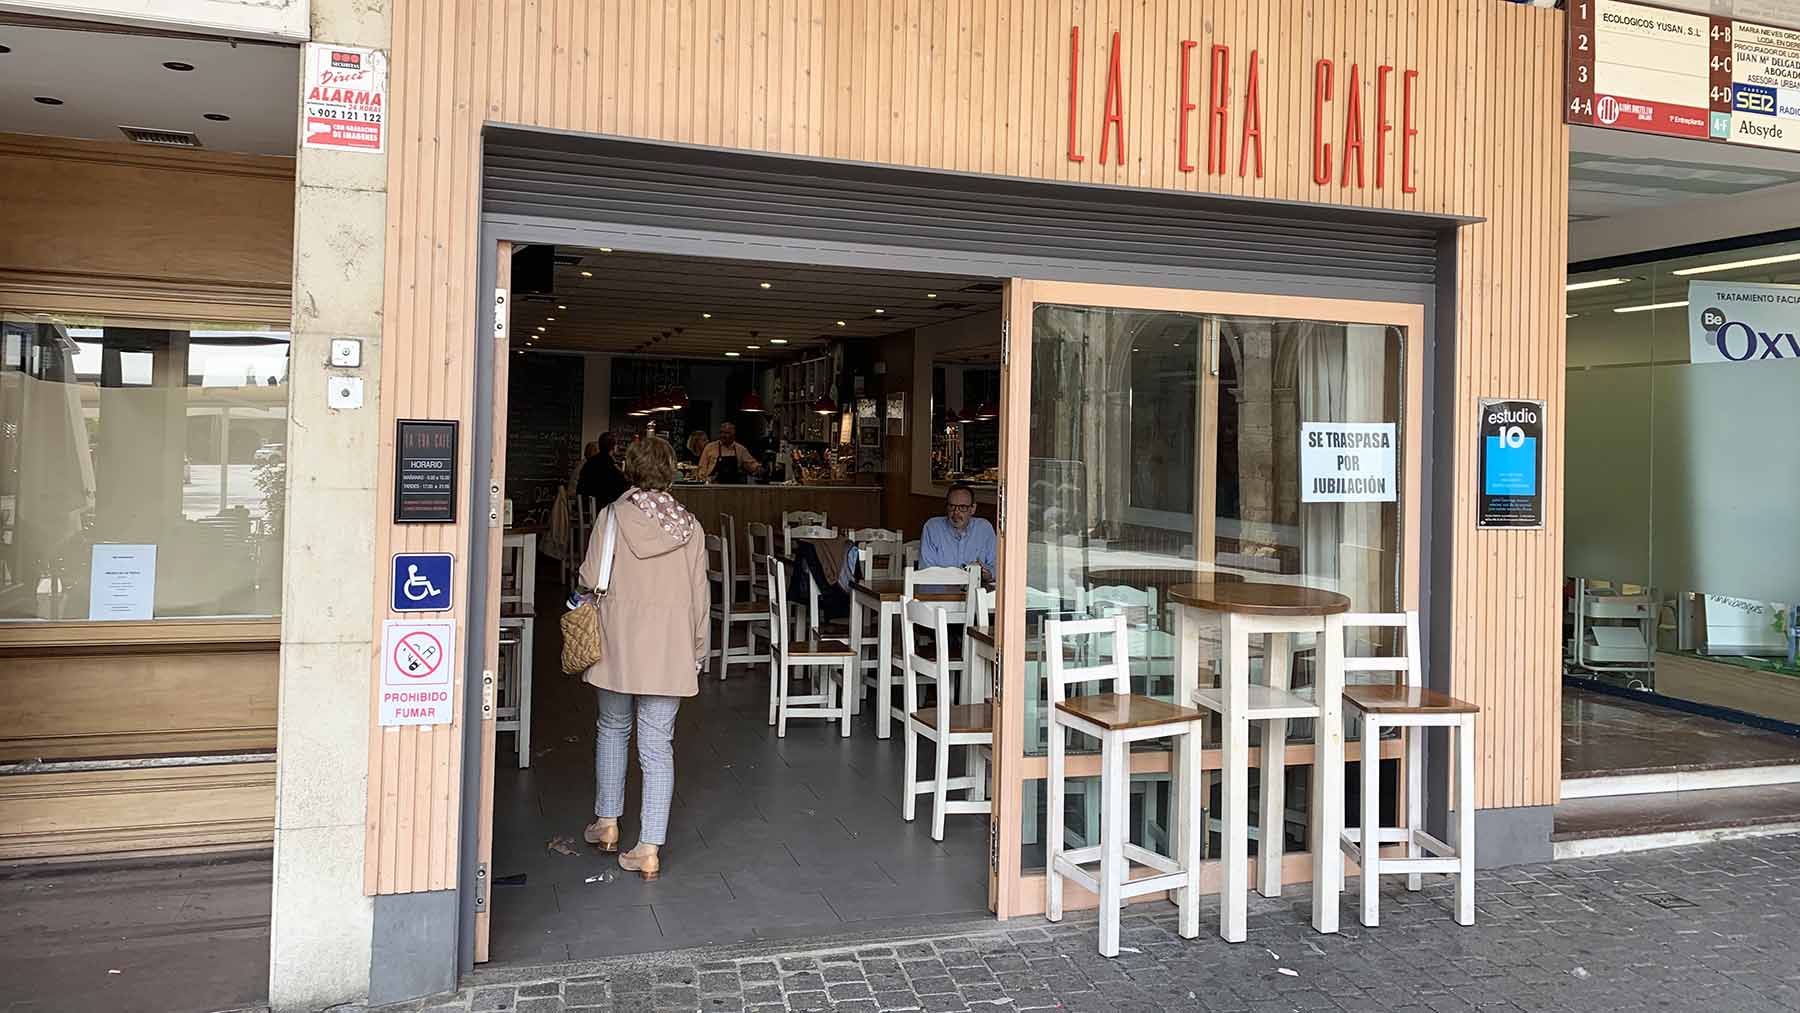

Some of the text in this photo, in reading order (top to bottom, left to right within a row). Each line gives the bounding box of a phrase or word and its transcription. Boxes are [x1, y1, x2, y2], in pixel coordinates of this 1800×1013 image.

[1579, 4, 1587, 20] 1
[1603, 13, 1654, 29] ECOLOGICOS
[1711, 25, 1731, 42] 4-B
[1578, 35, 1588, 51] 2
[1711, 55, 1731, 73] 4-C
[1737, 52, 1757, 63] JUAN
[321, 69, 370, 85] Direct
[1578, 66, 1588, 82] 3
[1747, 74, 1778, 85] ASESORIA
[308, 86, 382, 106] ALARMA
[1711, 85, 1731, 103] 4-D
[1736, 91, 1774, 113] SER
[1069, 26, 1419, 193] LA ERA CAFE
[1571, 97, 1592, 115] 4-A
[318, 108, 382, 122] 902 121 122
[1739, 120, 1783, 139] Absyde
[1716, 292, 1775, 303] TRATAMIENTO
[1704, 312, 1722, 325] Be
[1488, 408, 1537, 424] estudio
[1308, 431, 1390, 449] SE TRASPASA
[1499, 426, 1525, 448] 10
[410, 461, 442, 469] HORARIO
[1337, 455, 1360, 471] POR
[1312, 475, 1386, 494] JUBILACIÓN
[384, 691, 448, 702] PROHIBIDO
[395, 707, 435, 718] FUMAR
